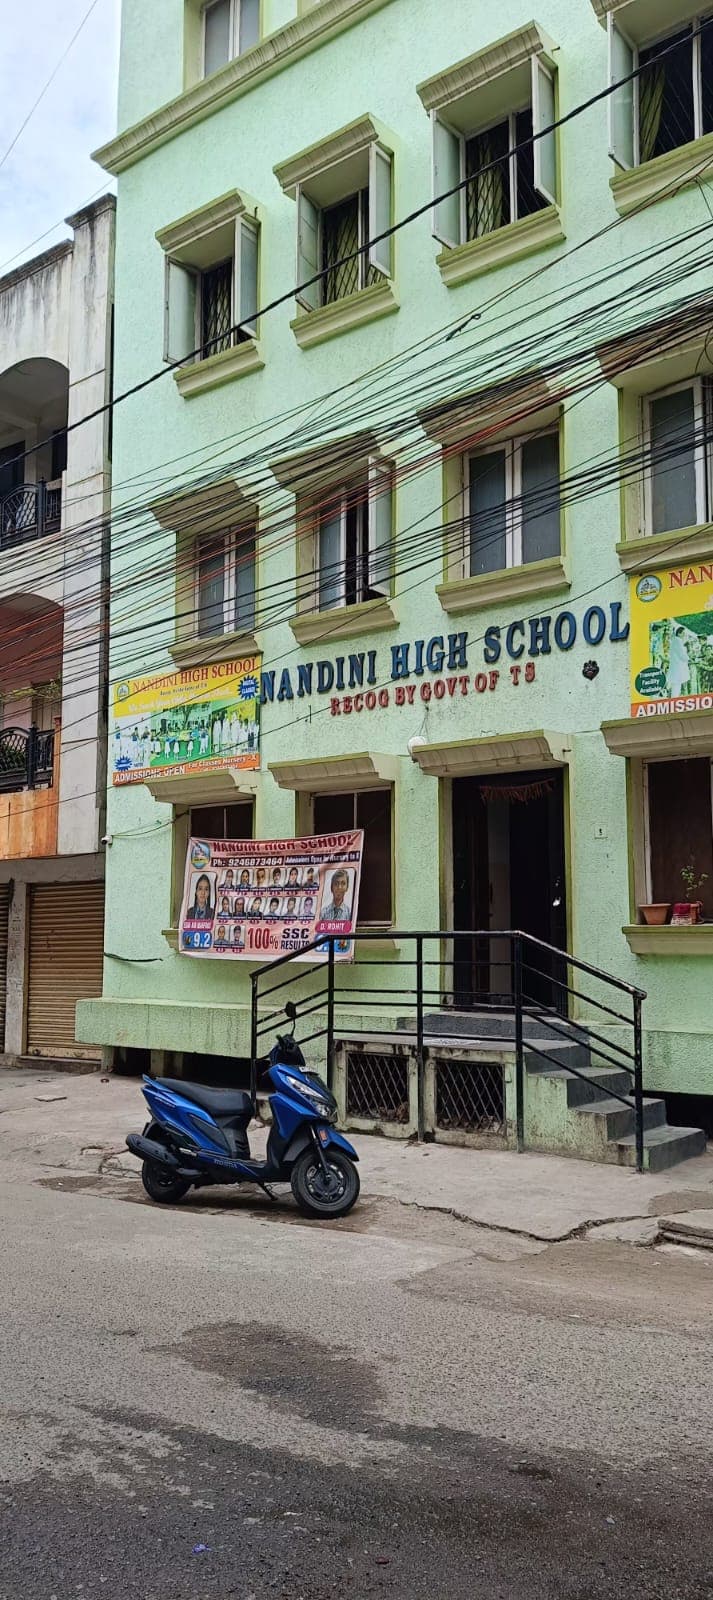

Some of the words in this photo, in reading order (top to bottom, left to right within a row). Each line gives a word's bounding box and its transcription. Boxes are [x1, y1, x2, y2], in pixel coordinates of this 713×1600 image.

[669, 565, 713, 588] NAN
[260, 649, 377, 704] NANDINI
[390, 630, 469, 680] HIGH
[484, 602, 630, 663] SCHOOL
[133, 674, 177, 692] NANDINI
[180, 668, 208, 684] HIGH
[212, 658, 256, 678] SCHOOL
[330, 689, 390, 716] RECOG
[395, 684, 416, 706] BY
[420, 674, 470, 701] GOVT
[475, 670, 499, 692] OF
[510, 664, 521, 685] T
[525, 662, 536, 682] S
[636, 696, 713, 718] ADMISSIO
[115, 768, 161, 782] ADMISSIONS
[164, 765, 185, 776] OPEN
[213, 842, 260, 852] NANDINI
[265, 842, 295, 850] HIGH
[300, 835, 353, 849] SCHOOL
[213, 858, 225, 866] Ph:
[194, 932, 210, 947] 9.2
[248, 927, 278, 949] 100%
[282, 928, 310, 939] SSC
